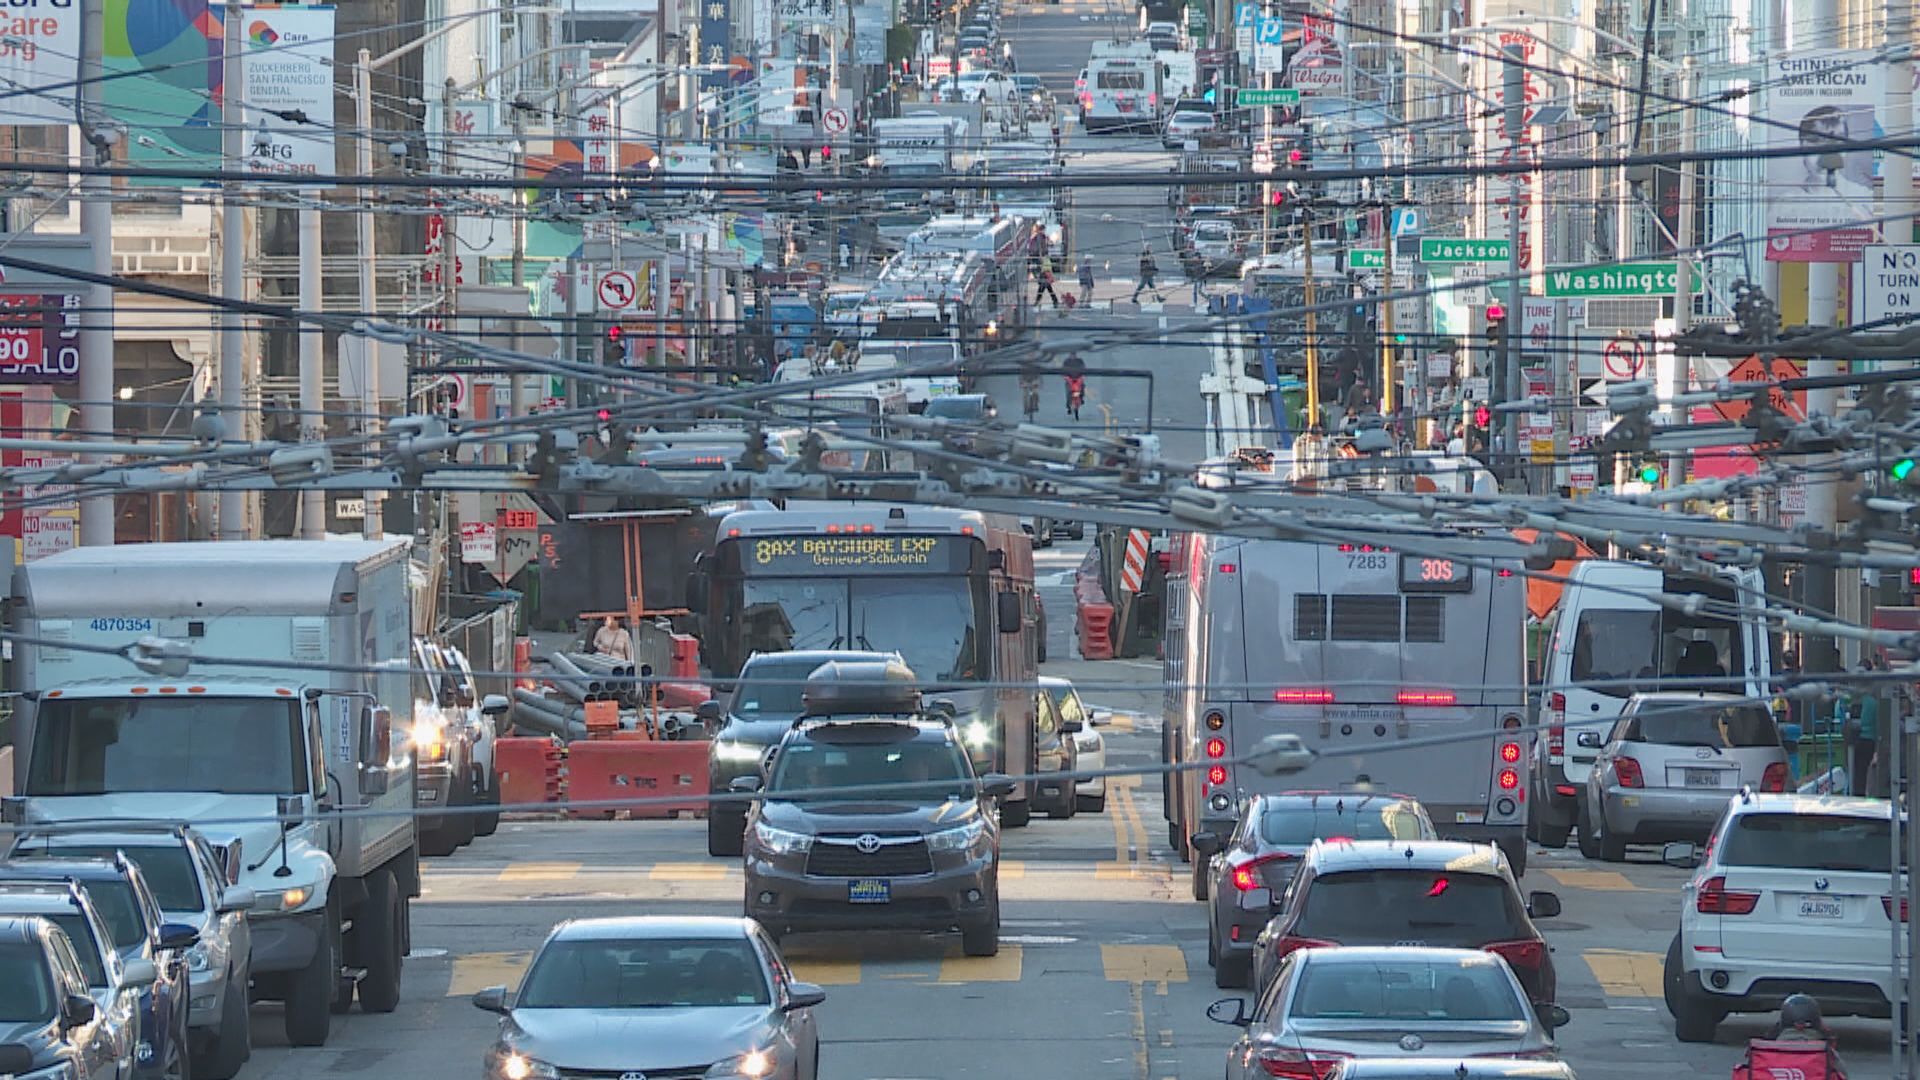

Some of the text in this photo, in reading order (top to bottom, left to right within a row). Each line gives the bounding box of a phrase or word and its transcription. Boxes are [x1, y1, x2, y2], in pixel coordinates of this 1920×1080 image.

[283, 32, 308, 41] Care
[1259, 20, 1278, 42] P
[249, 63, 311, 73] ZUCKERBERG
[1780, 59, 1853, 71] CHIN
[249, 74, 326, 85] SAN FRANCISCO
[1781, 72, 1867, 86] AMERICAN
[249, 86, 291, 96] GENERAL
[1245, 92, 1293, 103] Broadway
[1780, 88, 1813, 96] EXCLUSION
[1820, 88, 1853, 96] INCLUSION
[250, 161, 316, 174] Careorg
[1431, 244, 1509, 258] Jackson
[1884, 252, 1916, 269] NO
[1462, 269, 1479, 277] NO
[1553, 269, 1692, 293] Washingto
[1878, 274, 1919, 288] TURN
[1887, 292, 1910, 306] ON
[1525, 305, 1553, 317] TUNE
[1746, 369, 1788, 382] ROD
[24, 517, 72, 532] NO PARKING
[506, 511, 534, 527] LEF
[756, 538, 937, 564] 8AX BAYSHORE EXP
[1346, 555, 1387, 570] 7283
[1421, 559, 1453, 581] 30S
[90, 618, 151, 631] 4870354
